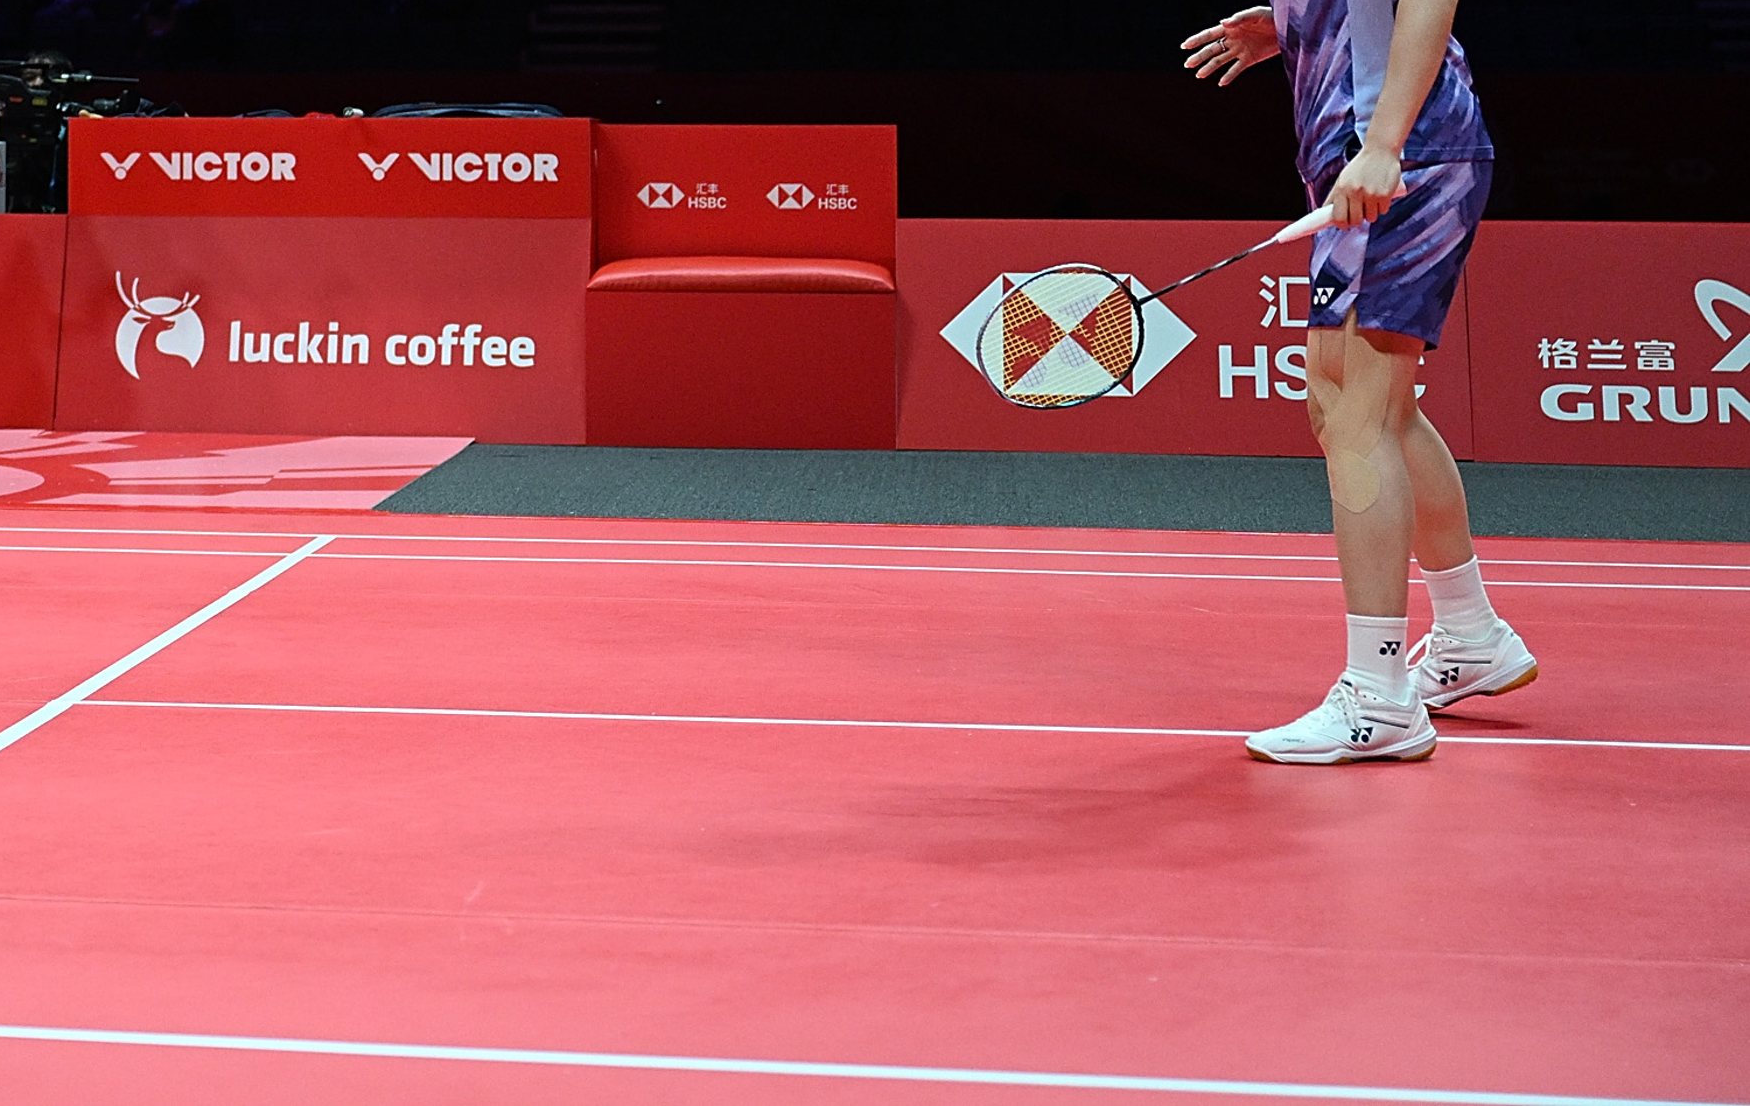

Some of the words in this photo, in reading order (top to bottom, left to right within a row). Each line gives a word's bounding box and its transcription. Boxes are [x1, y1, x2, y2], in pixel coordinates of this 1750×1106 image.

[149, 151, 296, 181] VICTOR
[407, 152, 559, 182] VICTOR
[687, 196, 727, 209] HSBC
[695, 183, 720, 195] 汇丰
[817, 197, 858, 210] HSBC
[826, 183, 850, 196] 汇丰
[1259, 274, 1310, 328] 汇
[228, 320, 370, 365] luckin
[384, 323, 536, 368] coffee
[1537, 337, 1677, 371] 格兰富
